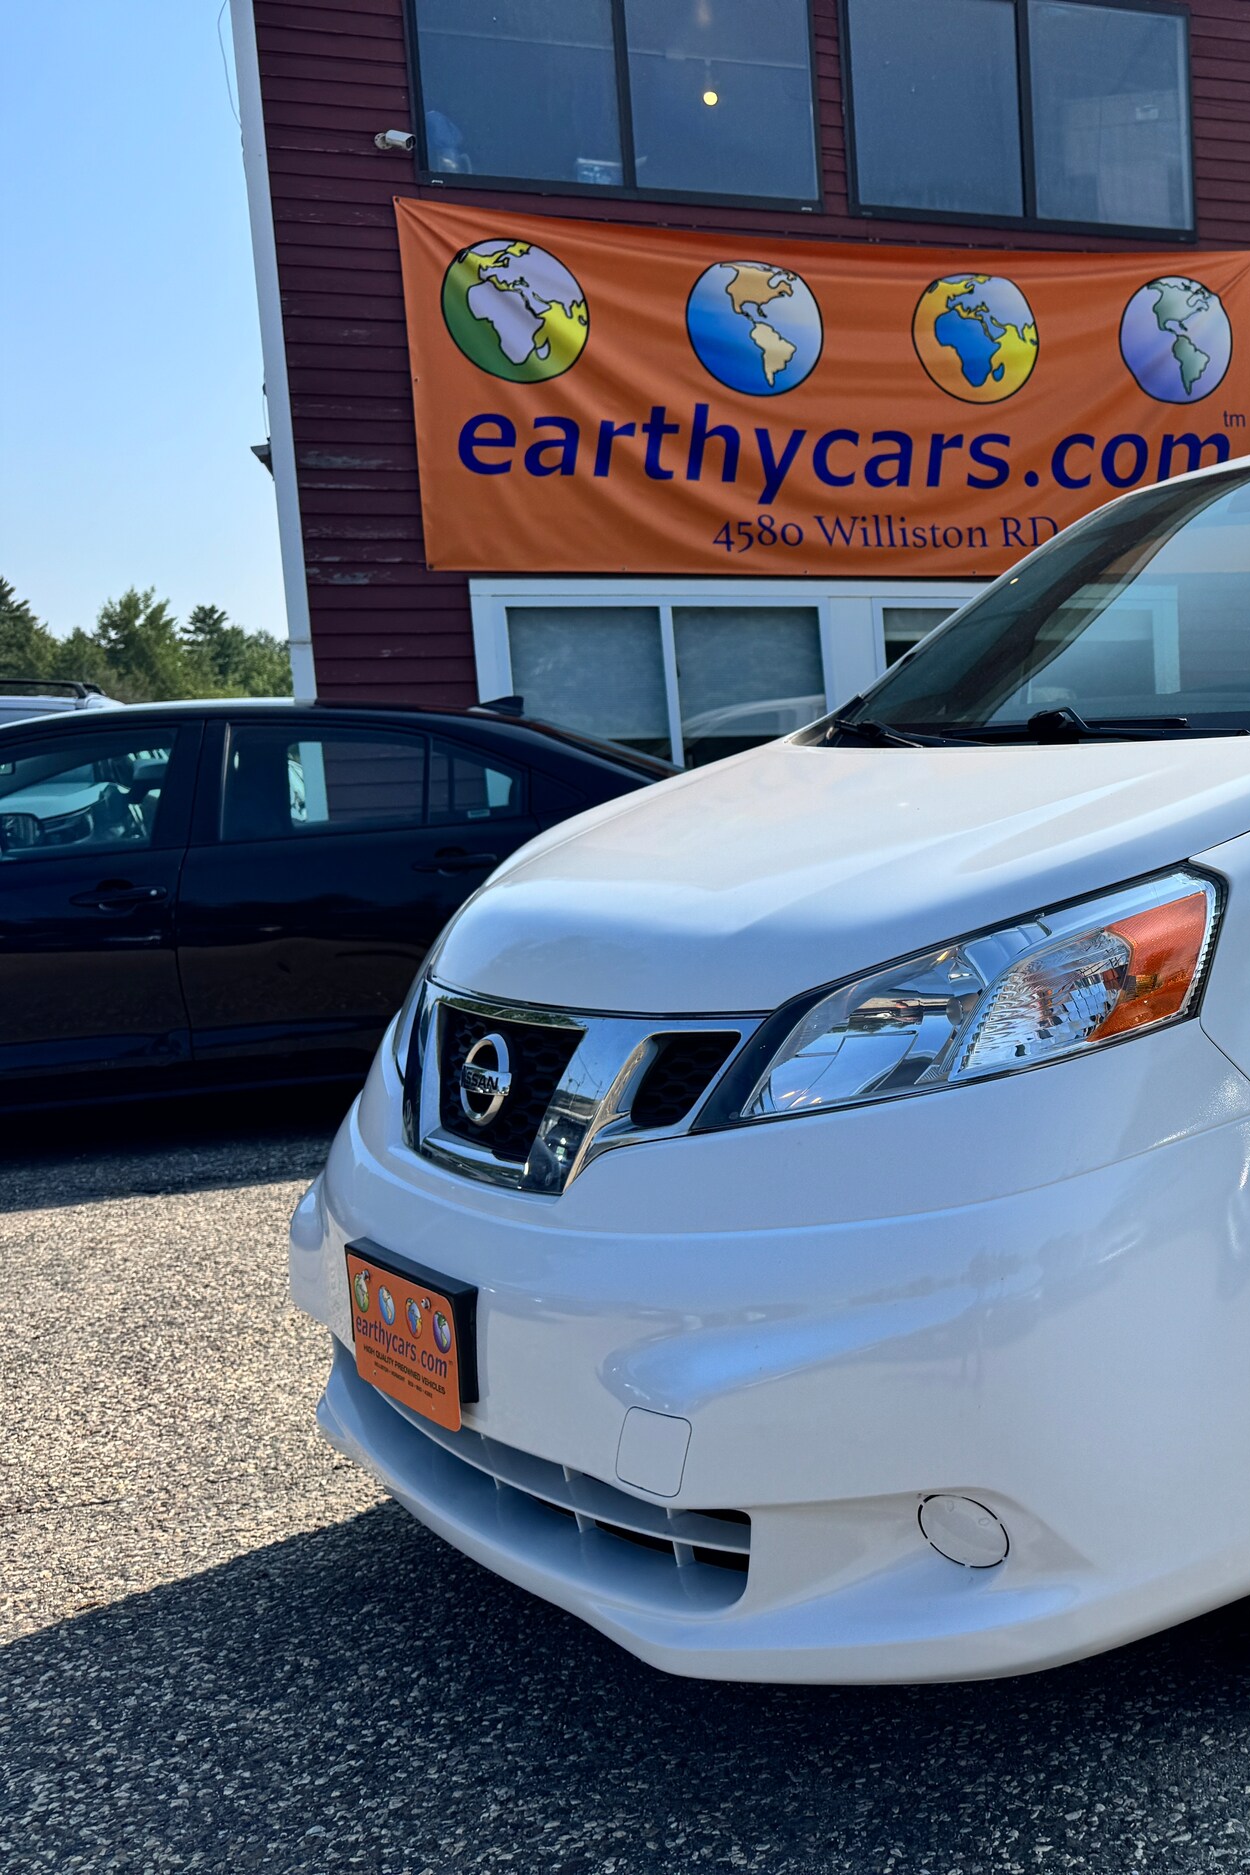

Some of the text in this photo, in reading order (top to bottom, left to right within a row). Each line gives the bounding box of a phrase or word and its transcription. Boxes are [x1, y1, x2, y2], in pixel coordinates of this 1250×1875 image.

[1223, 410, 1246, 428] tm
[457, 402, 1230, 504] earthycars.com
[713, 514, 1060, 553] 4580 Williston RD
[462, 1066, 499, 1091] SSAN
[356, 1316, 447, 1378] earthycars.com
